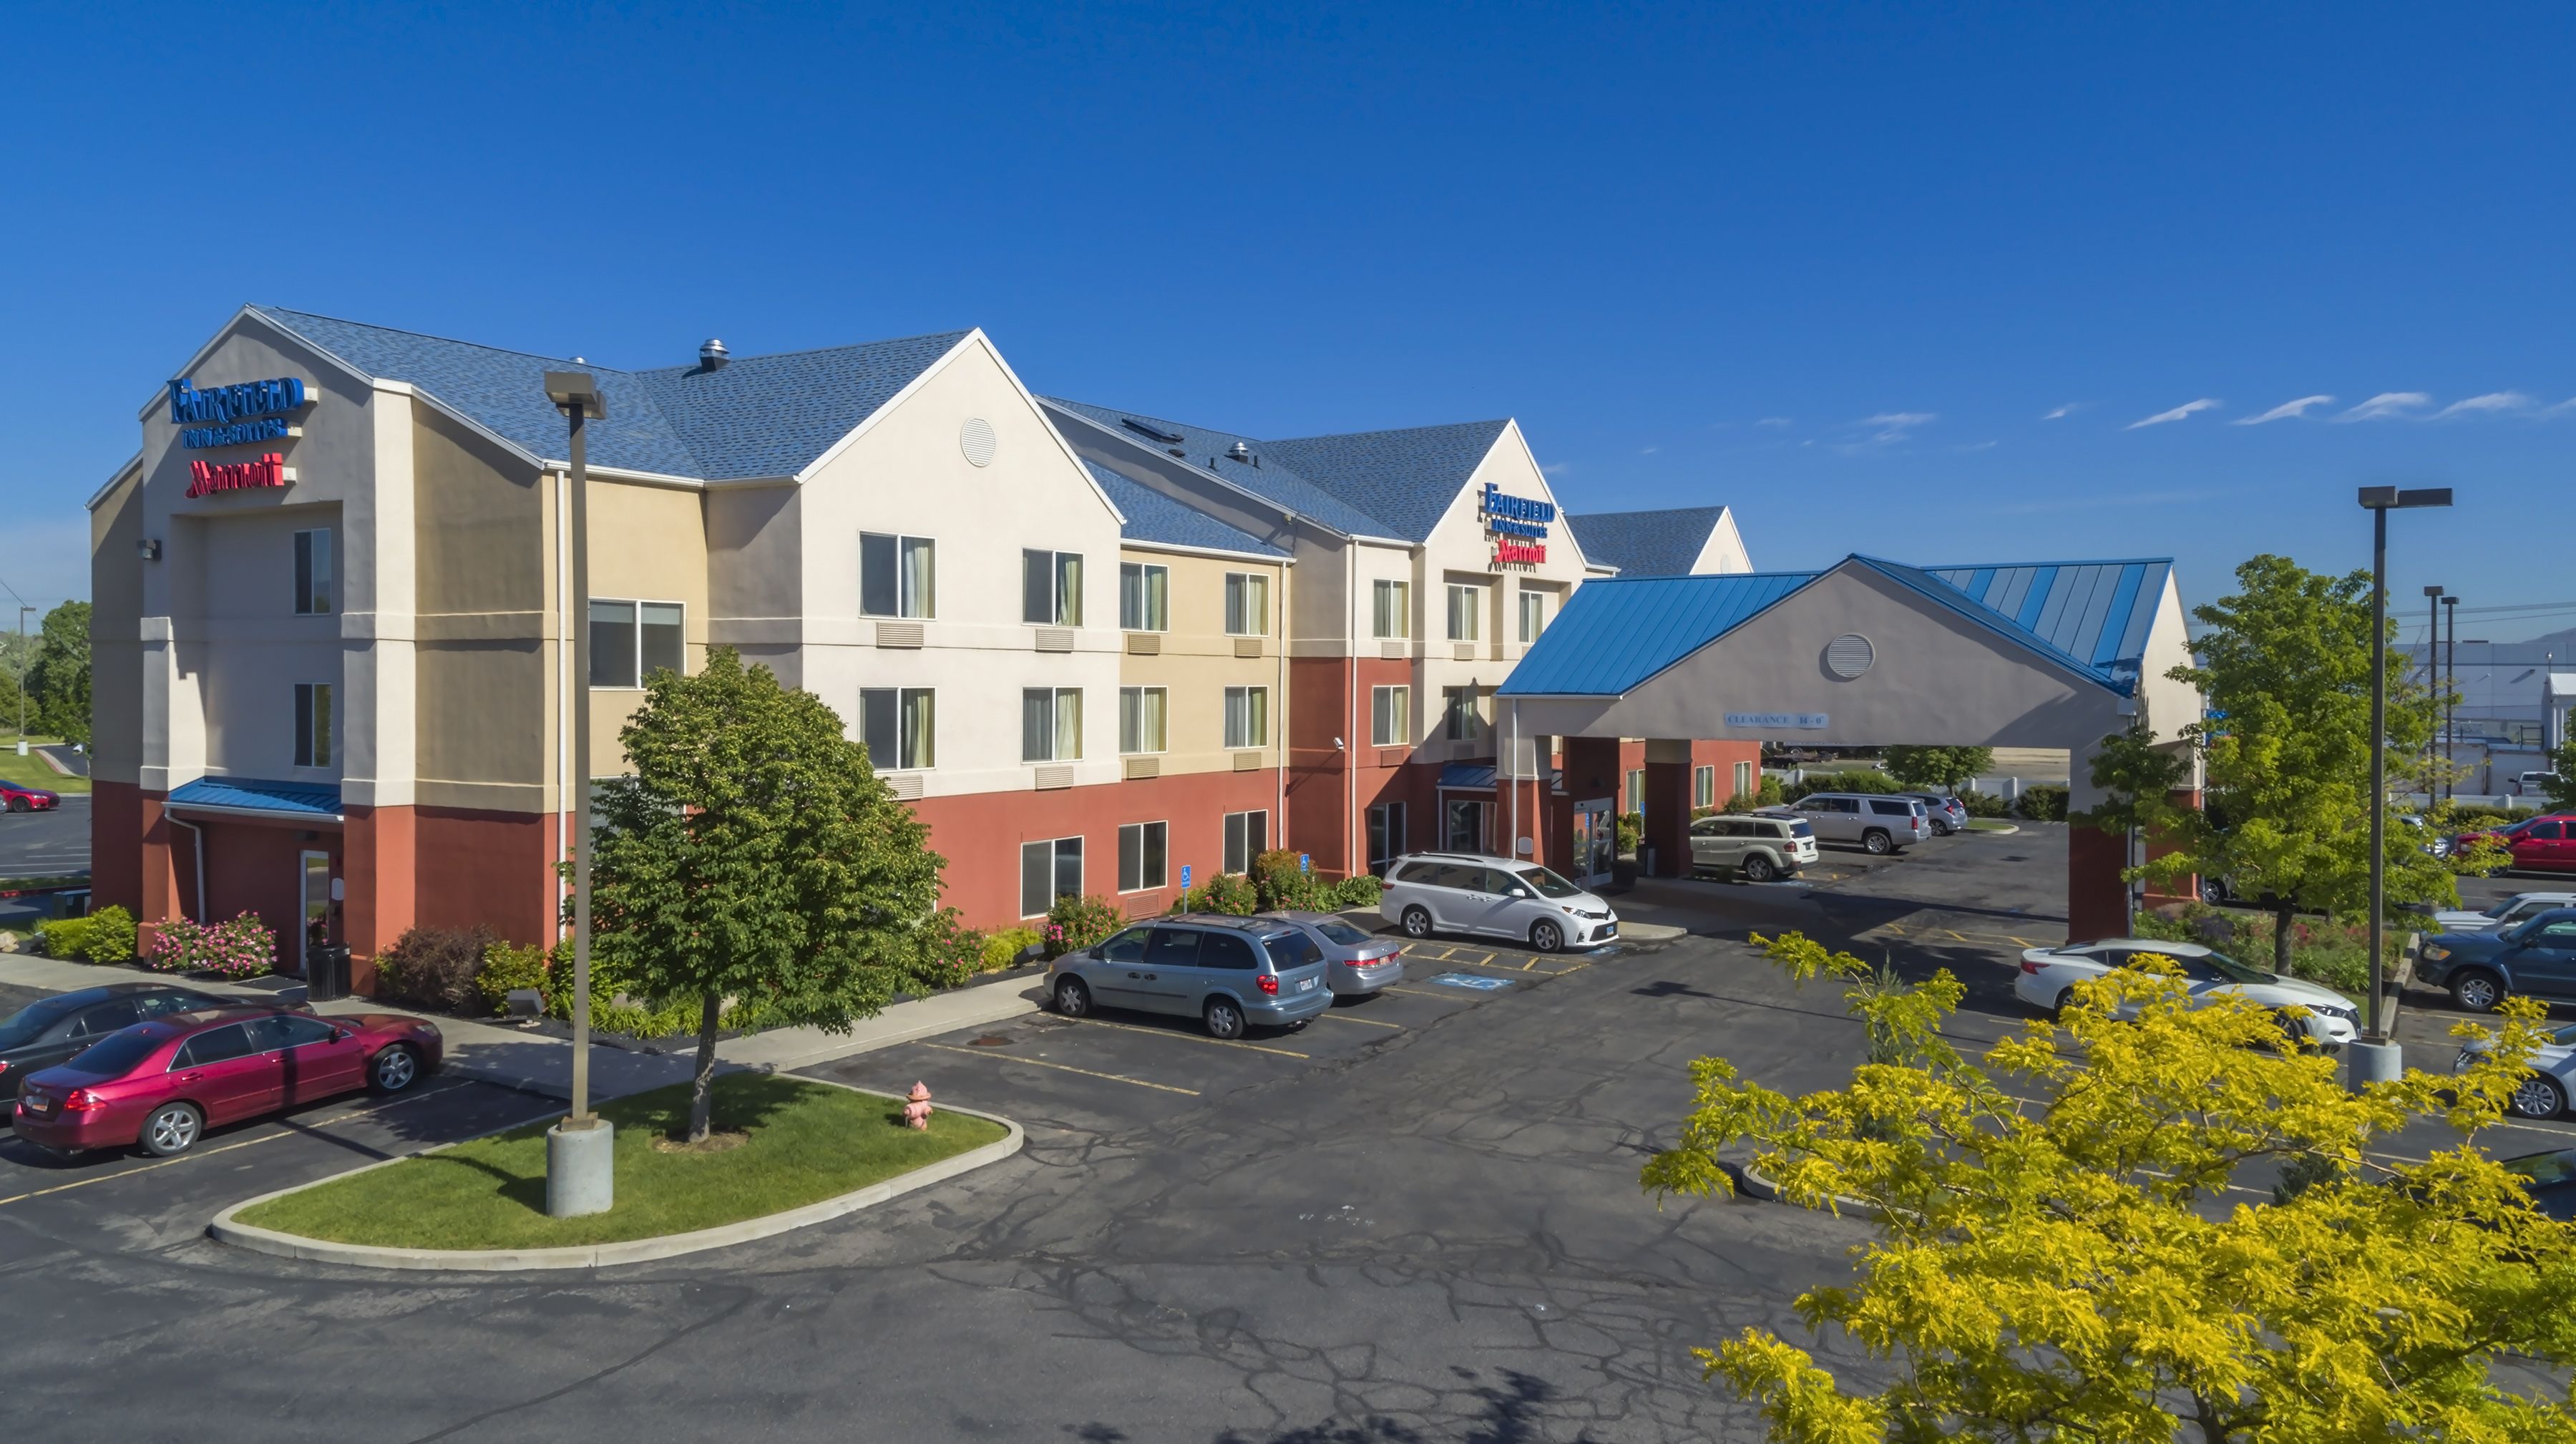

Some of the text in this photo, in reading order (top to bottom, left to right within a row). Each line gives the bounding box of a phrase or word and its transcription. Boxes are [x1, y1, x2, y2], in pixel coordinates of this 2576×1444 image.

[167, 377, 304, 424] FAIRFIELD
[183, 428, 212, 449] INN
[185, 453, 285, 498] Marriott
[1484, 482, 1556, 523] FAIRFIELD
[1492, 519, 1513, 535] INN
[1495, 539, 1546, 564] Marriott
[1728, 716, 1789, 724] CLEARANCE
